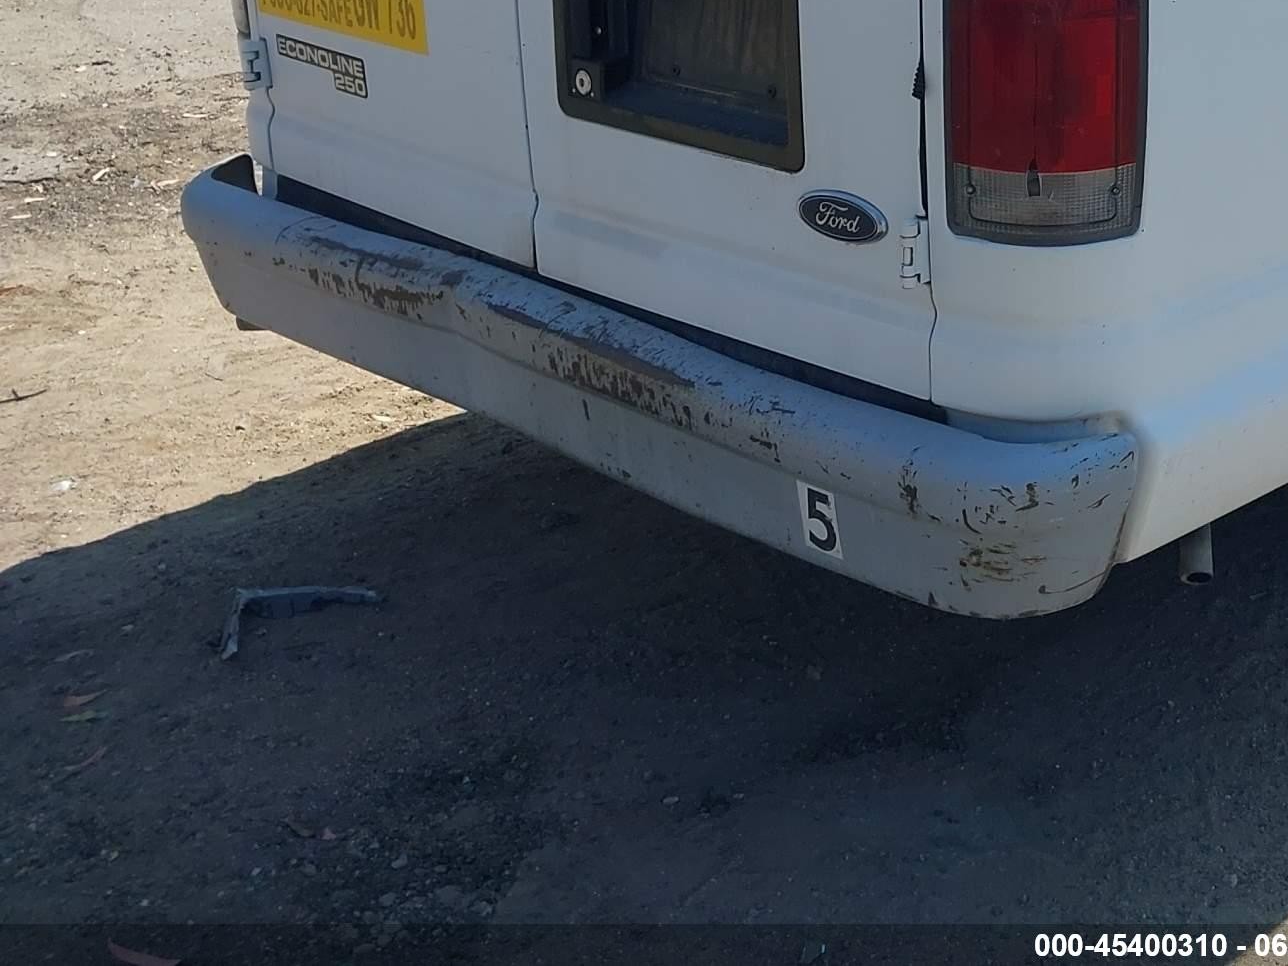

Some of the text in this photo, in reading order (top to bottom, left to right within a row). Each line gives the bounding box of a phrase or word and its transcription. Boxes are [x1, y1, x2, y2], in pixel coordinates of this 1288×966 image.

[278, 37, 364, 78] ECONOLINE
[335, 73, 366, 96] 250
[815, 201, 861, 233] Ford
[807, 487, 837, 552] 5
